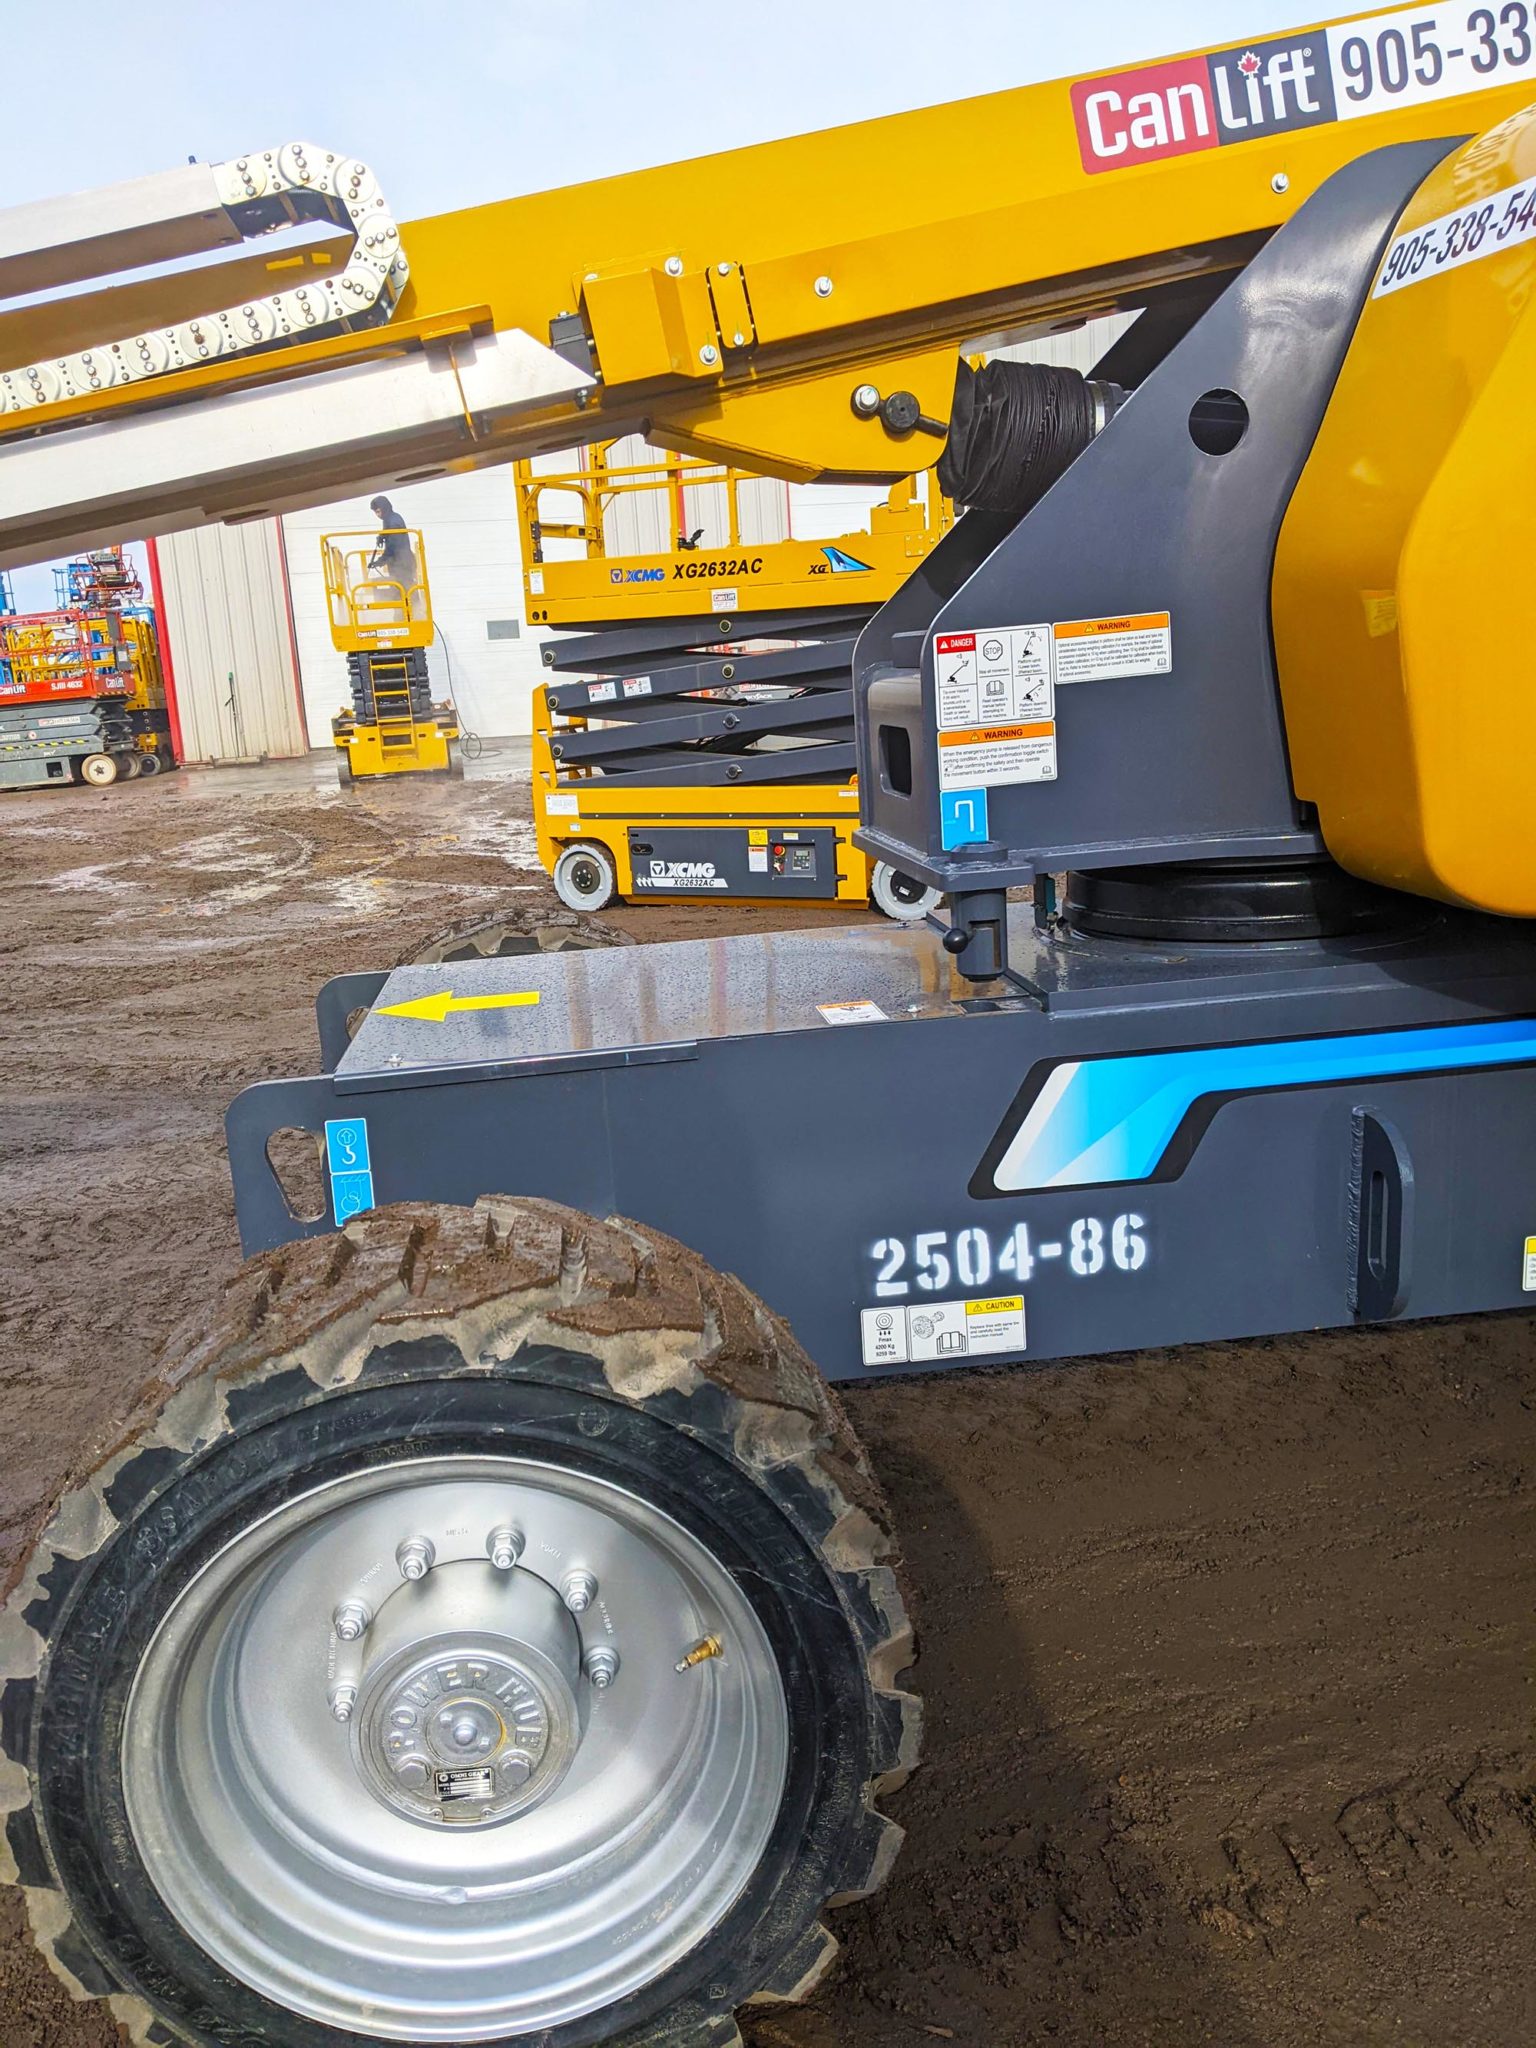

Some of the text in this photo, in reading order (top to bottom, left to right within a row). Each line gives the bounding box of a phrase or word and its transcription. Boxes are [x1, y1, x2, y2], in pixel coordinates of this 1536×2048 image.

[1341, 0, 1536, 101] 905-33
[1382, 186, 1536, 286] 905-338-54
[624, 558, 763, 583] XCMG XG2632AC
[1097, 621, 1131, 631] WARNING
[950, 638, 973, 647] DANGER
[985, 647, 1001, 656] STOP
[984, 728, 1023, 740] WARNING
[666, 862, 716, 878] XCMG
[673, 879, 716, 887] XG2632AC
[872, 1214, 1147, 1297] 2504-86
[986, 1301, 1015, 1310] CAUTION
